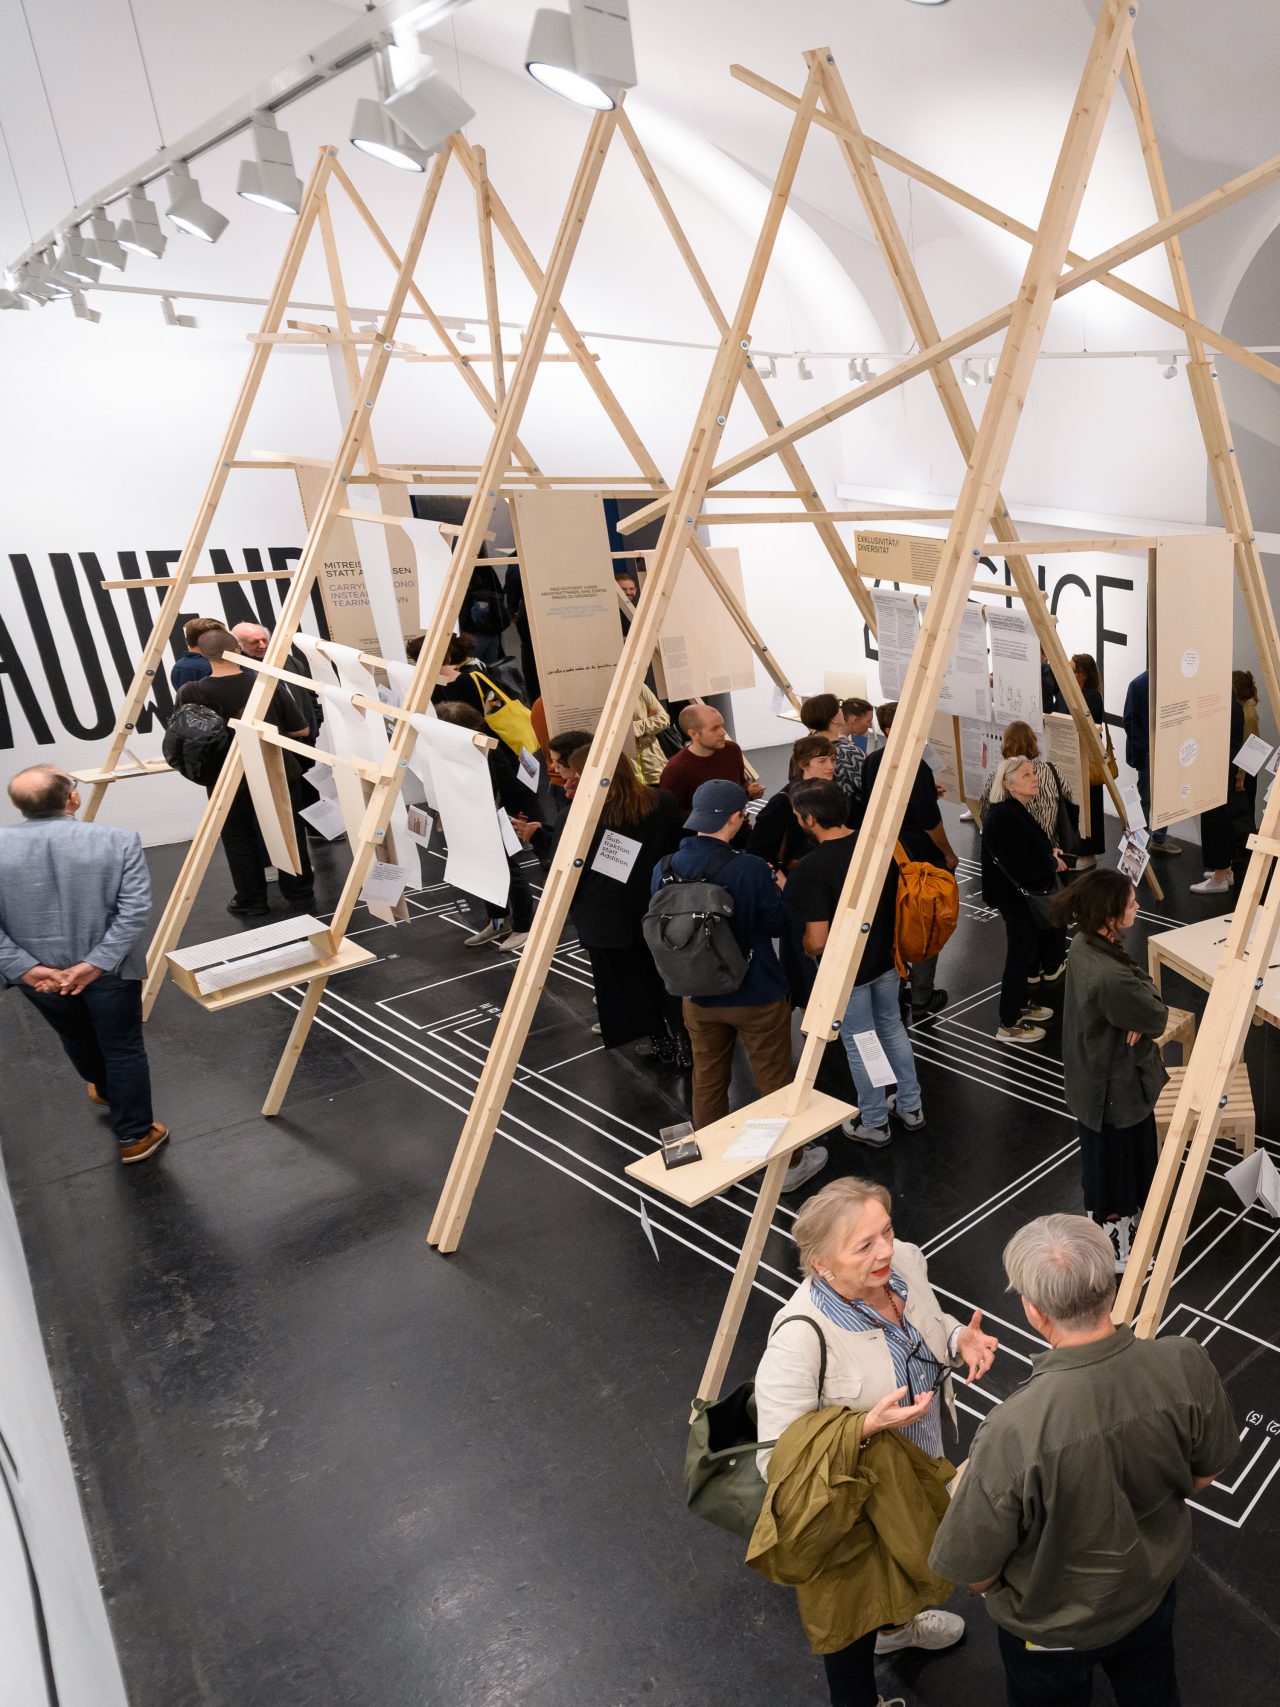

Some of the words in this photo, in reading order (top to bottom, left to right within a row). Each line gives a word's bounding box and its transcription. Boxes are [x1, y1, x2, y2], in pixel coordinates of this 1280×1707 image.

[324, 561, 362, 569] MITREIS
[606, 834, 623, 844] Sub-
[602, 846, 618, 855] statt
[604, 840, 630, 854] traktion
[1245, 1410, 1264, 1426] (3)
